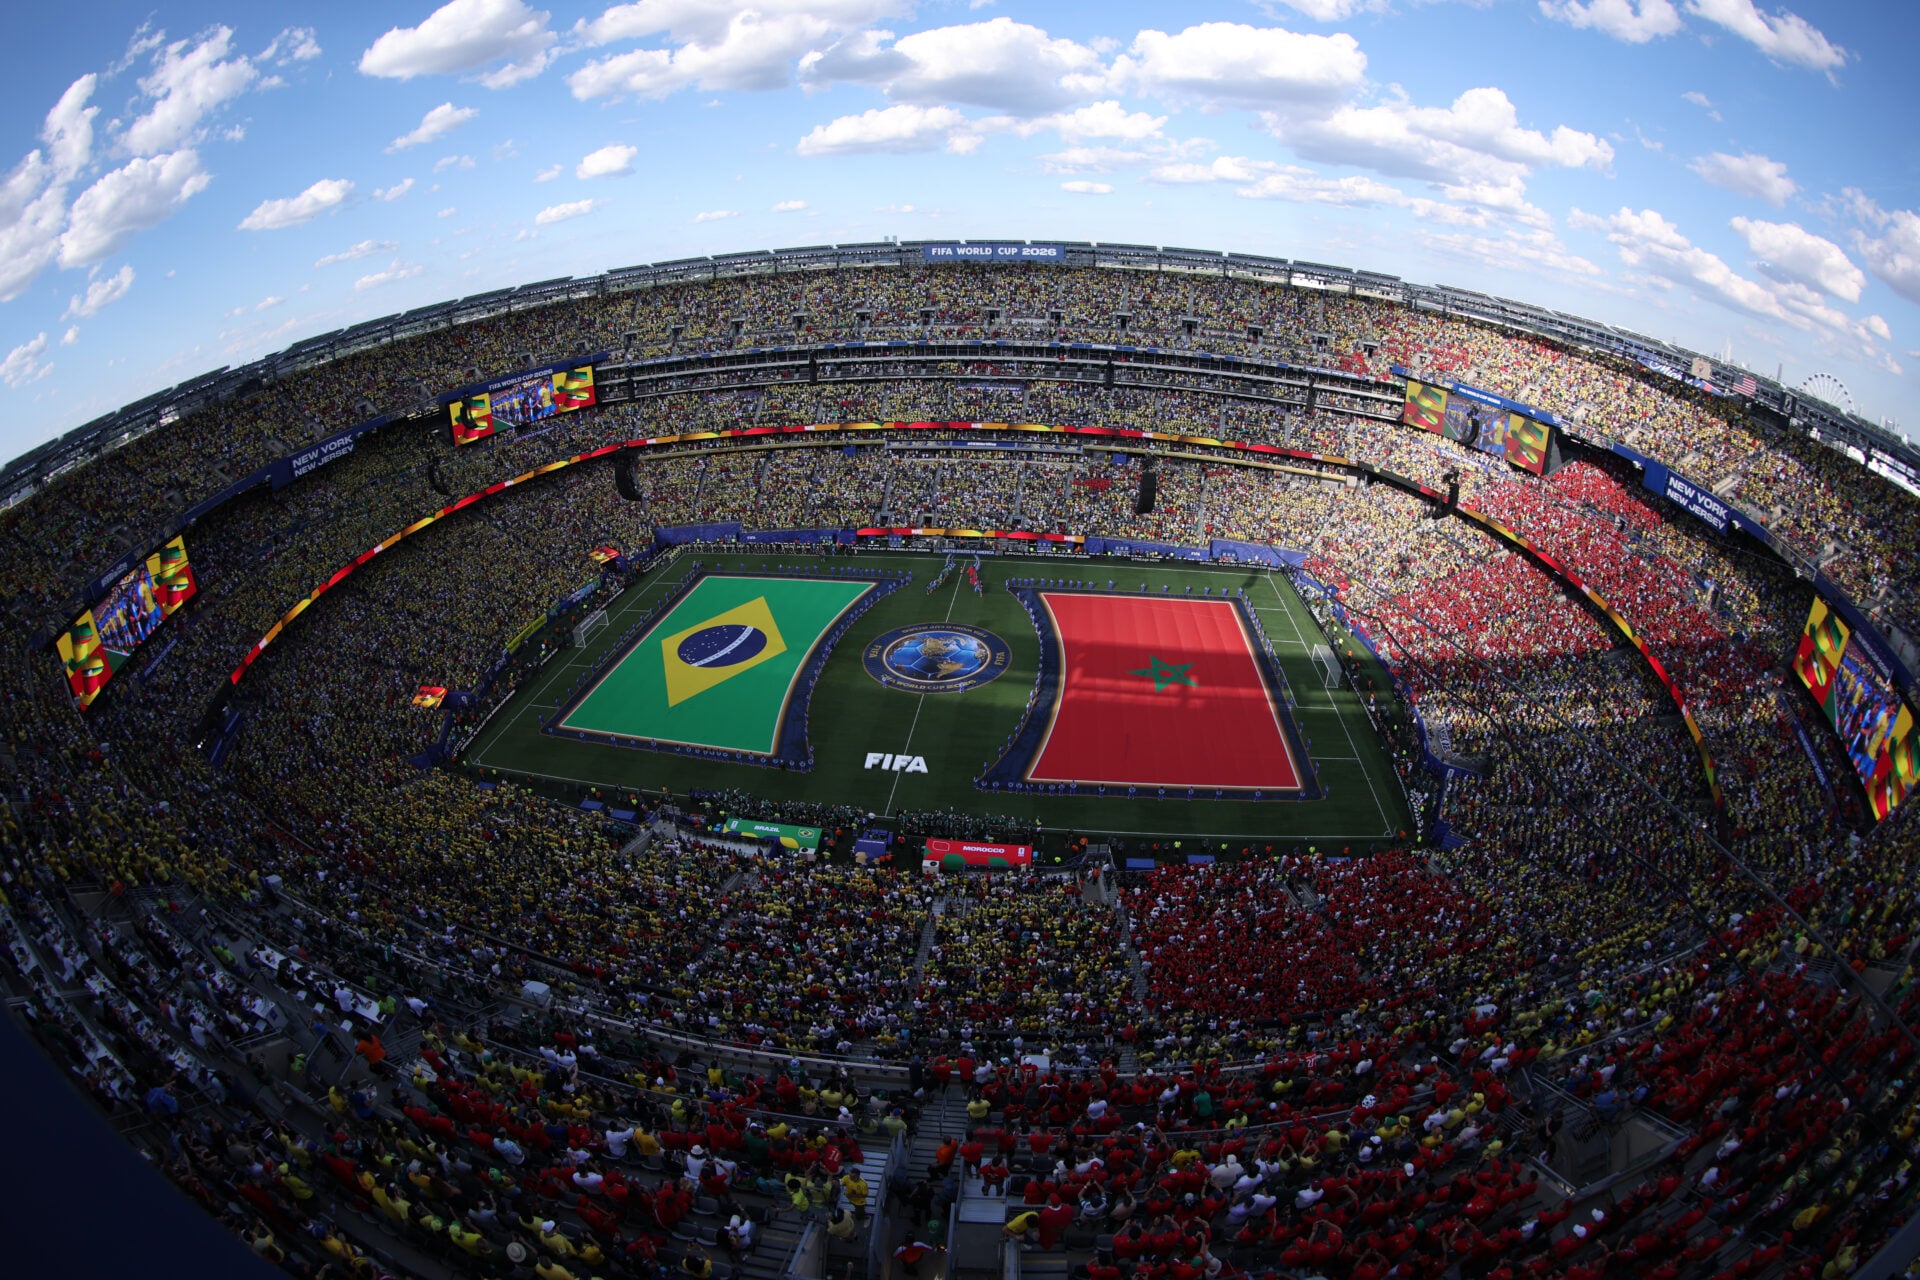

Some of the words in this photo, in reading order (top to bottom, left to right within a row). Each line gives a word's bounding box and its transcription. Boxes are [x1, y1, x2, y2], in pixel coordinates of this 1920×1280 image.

[932, 247, 952, 256] FIFA
[957, 247, 992, 256] WORLD
[998, 248, 1018, 256] CUP
[1022, 248, 1056, 256] 2026
[502, 377, 521, 386] WORLD
[292, 449, 318, 468] NEW
[321, 434, 353, 453] YORK
[294, 461, 316, 477] NEW
[318, 444, 354, 466] JERSEY
[1667, 488, 1688, 506] NEW
[1689, 504, 1725, 530] JERSEY
[1669, 477, 1695, 498] NEW
[1697, 492, 1728, 520] YORK
[897, 681, 926, 689] WORLD
[864, 752, 928, 773] FIFA
